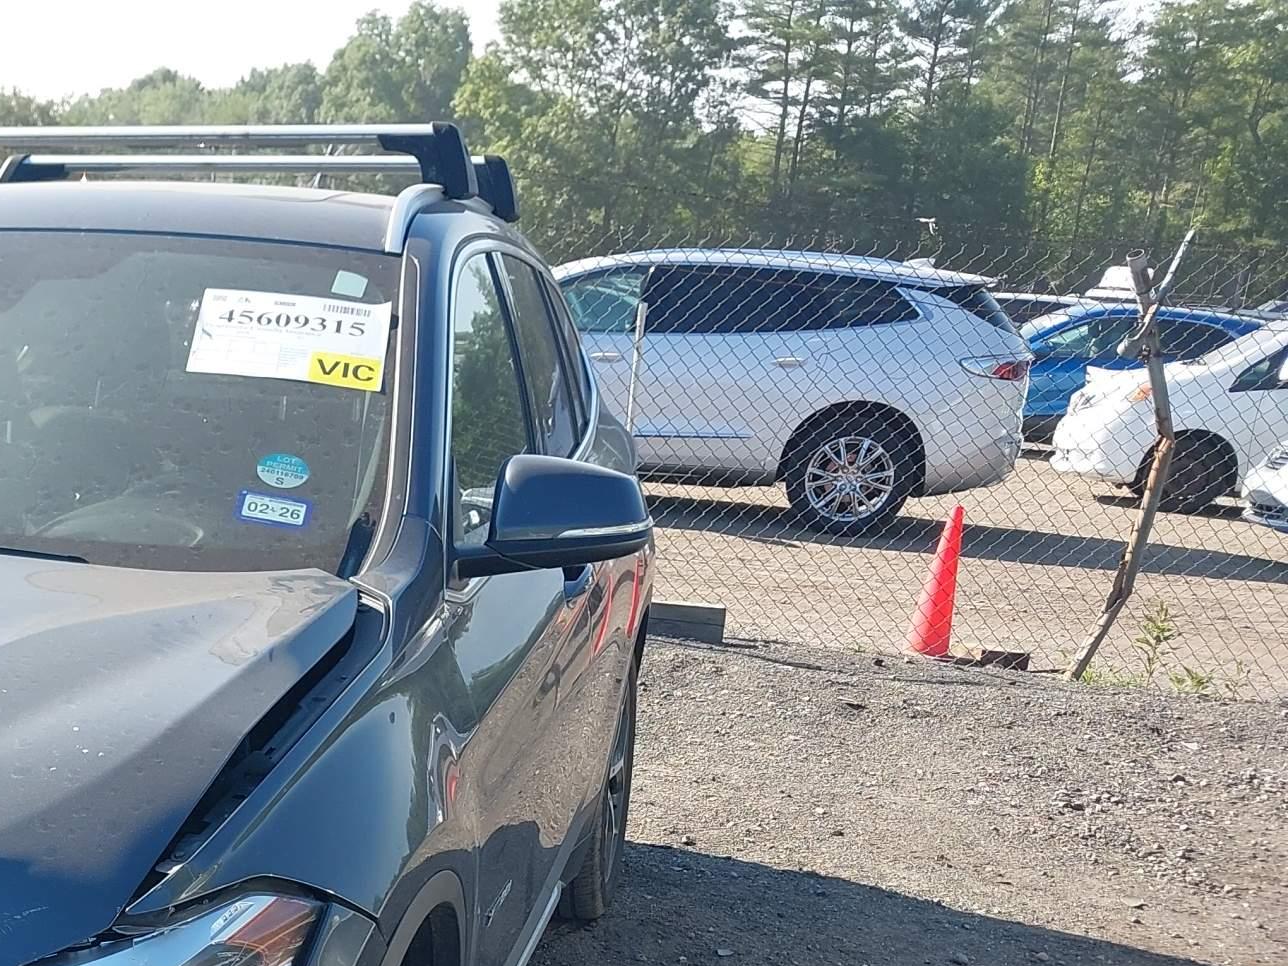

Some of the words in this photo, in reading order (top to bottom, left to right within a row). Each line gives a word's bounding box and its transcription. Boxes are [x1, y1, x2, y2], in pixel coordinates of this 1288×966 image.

[218, 308, 366, 337] 45609315
[316, 358, 375, 382] VIC
[266, 460, 303, 473] PERMIT
[276, 455, 296, 464] LOT
[274, 476, 285, 486] S
[247, 501, 270, 515] 02
[278, 506, 302, 520] 26
